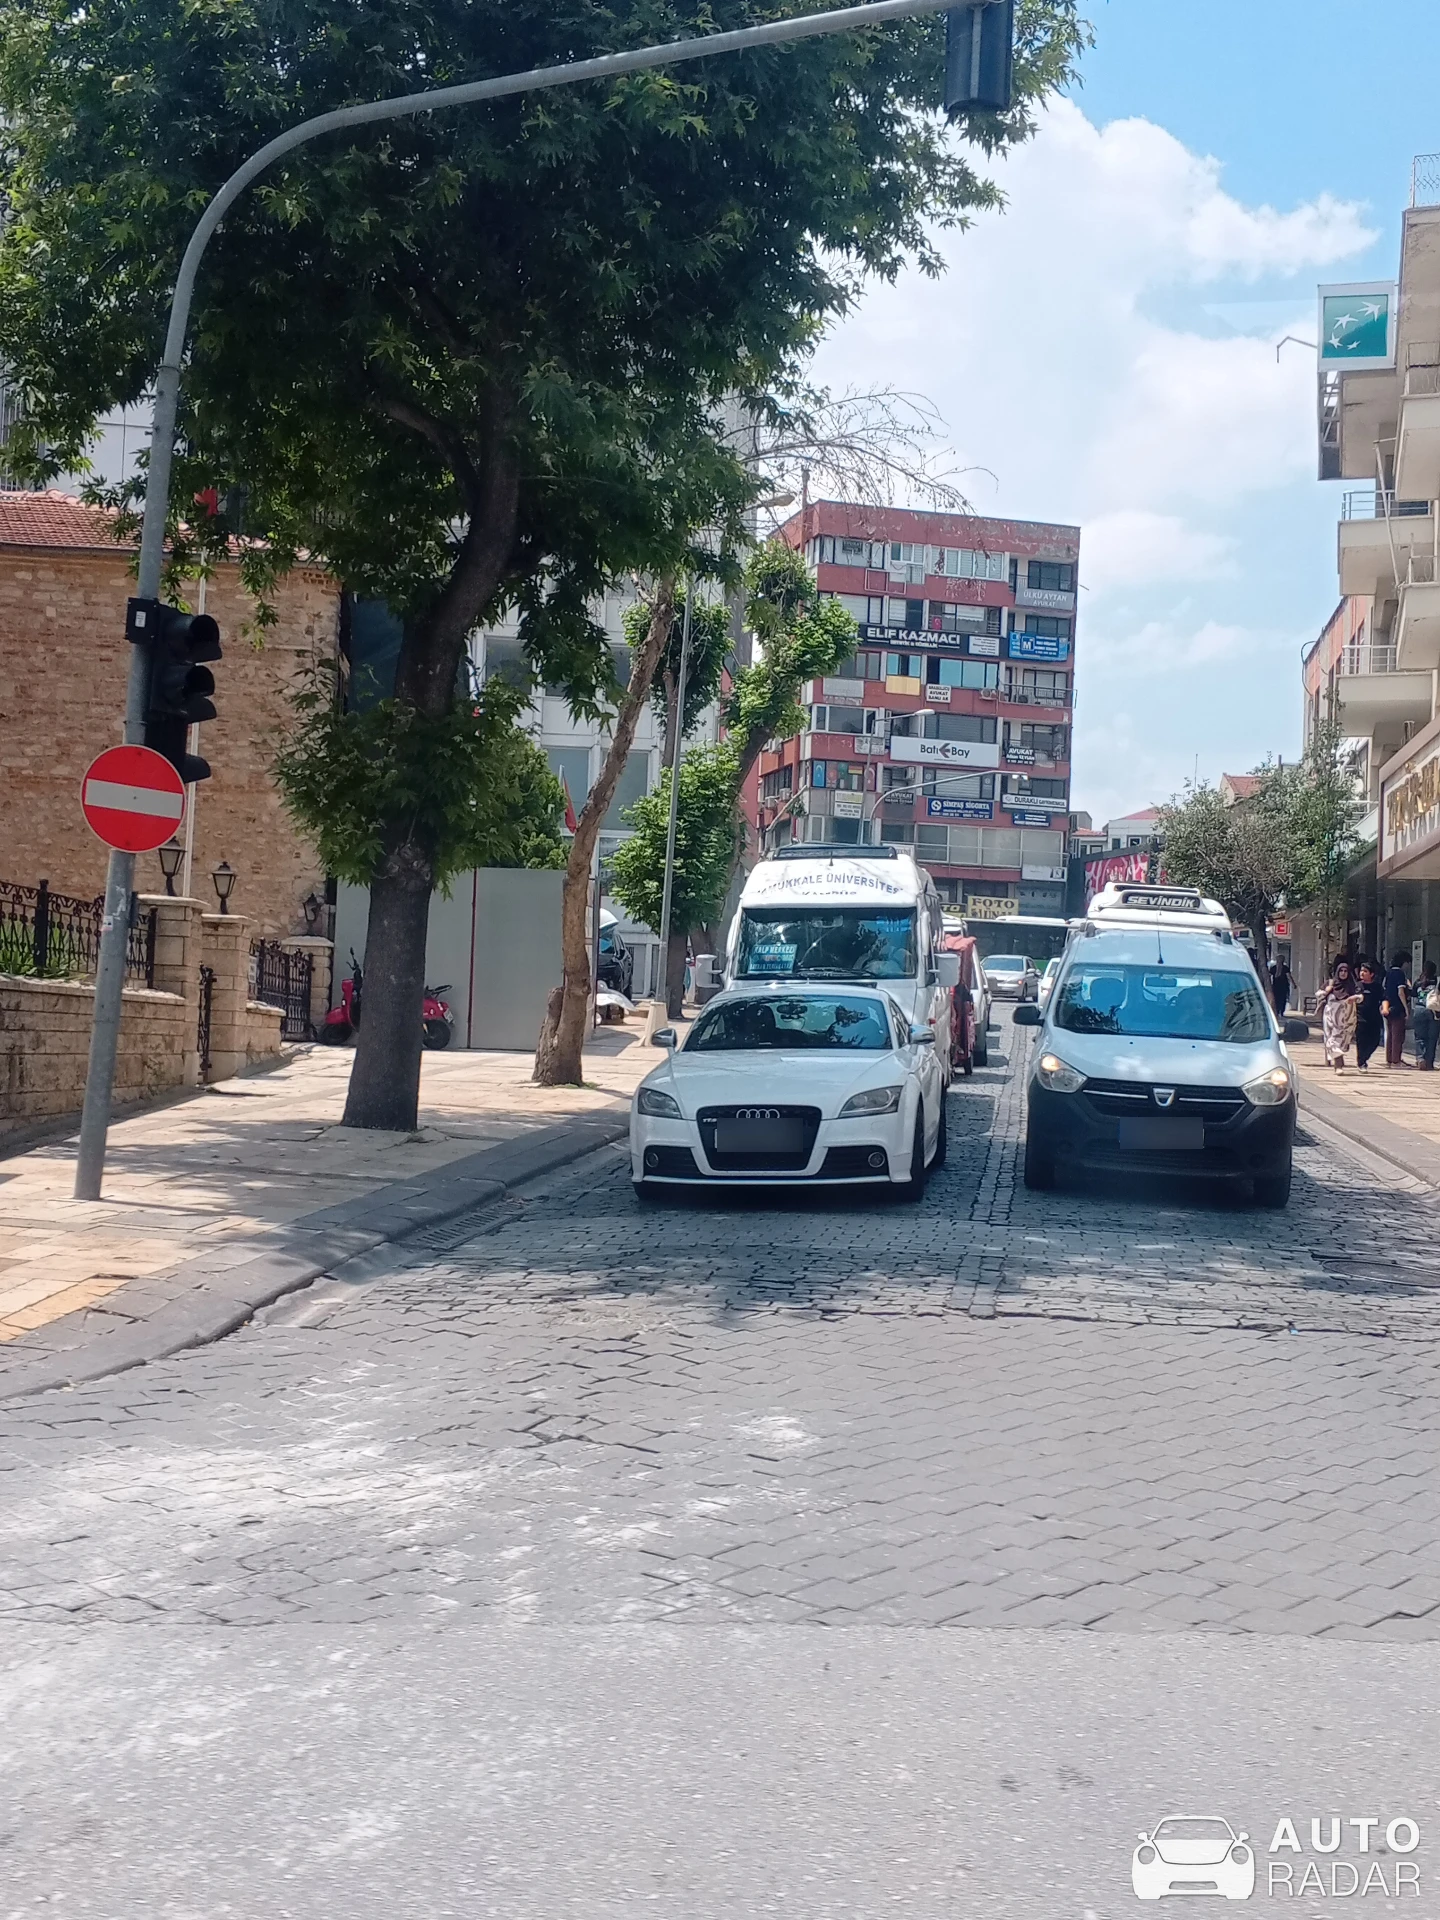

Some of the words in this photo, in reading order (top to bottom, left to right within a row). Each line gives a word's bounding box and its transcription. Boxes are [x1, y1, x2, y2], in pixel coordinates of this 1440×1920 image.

[1023, 589, 1043, 600] ÜLKÜ
[1043, 593, 1068, 602] AYTAN
[1033, 600, 1057, 608] AVUKAT
[898, 629, 960, 645] KAZMACI
[920, 743, 939, 755] Batı
[951, 746, 971, 759] Bay
[1008, 747, 1034, 756] AVUKAT
[825, 873, 904, 895] ÜNİVERSİTES
[971, 897, 1015, 909] FOTO
[1126, 895, 1196, 908] SEVİNDİK
